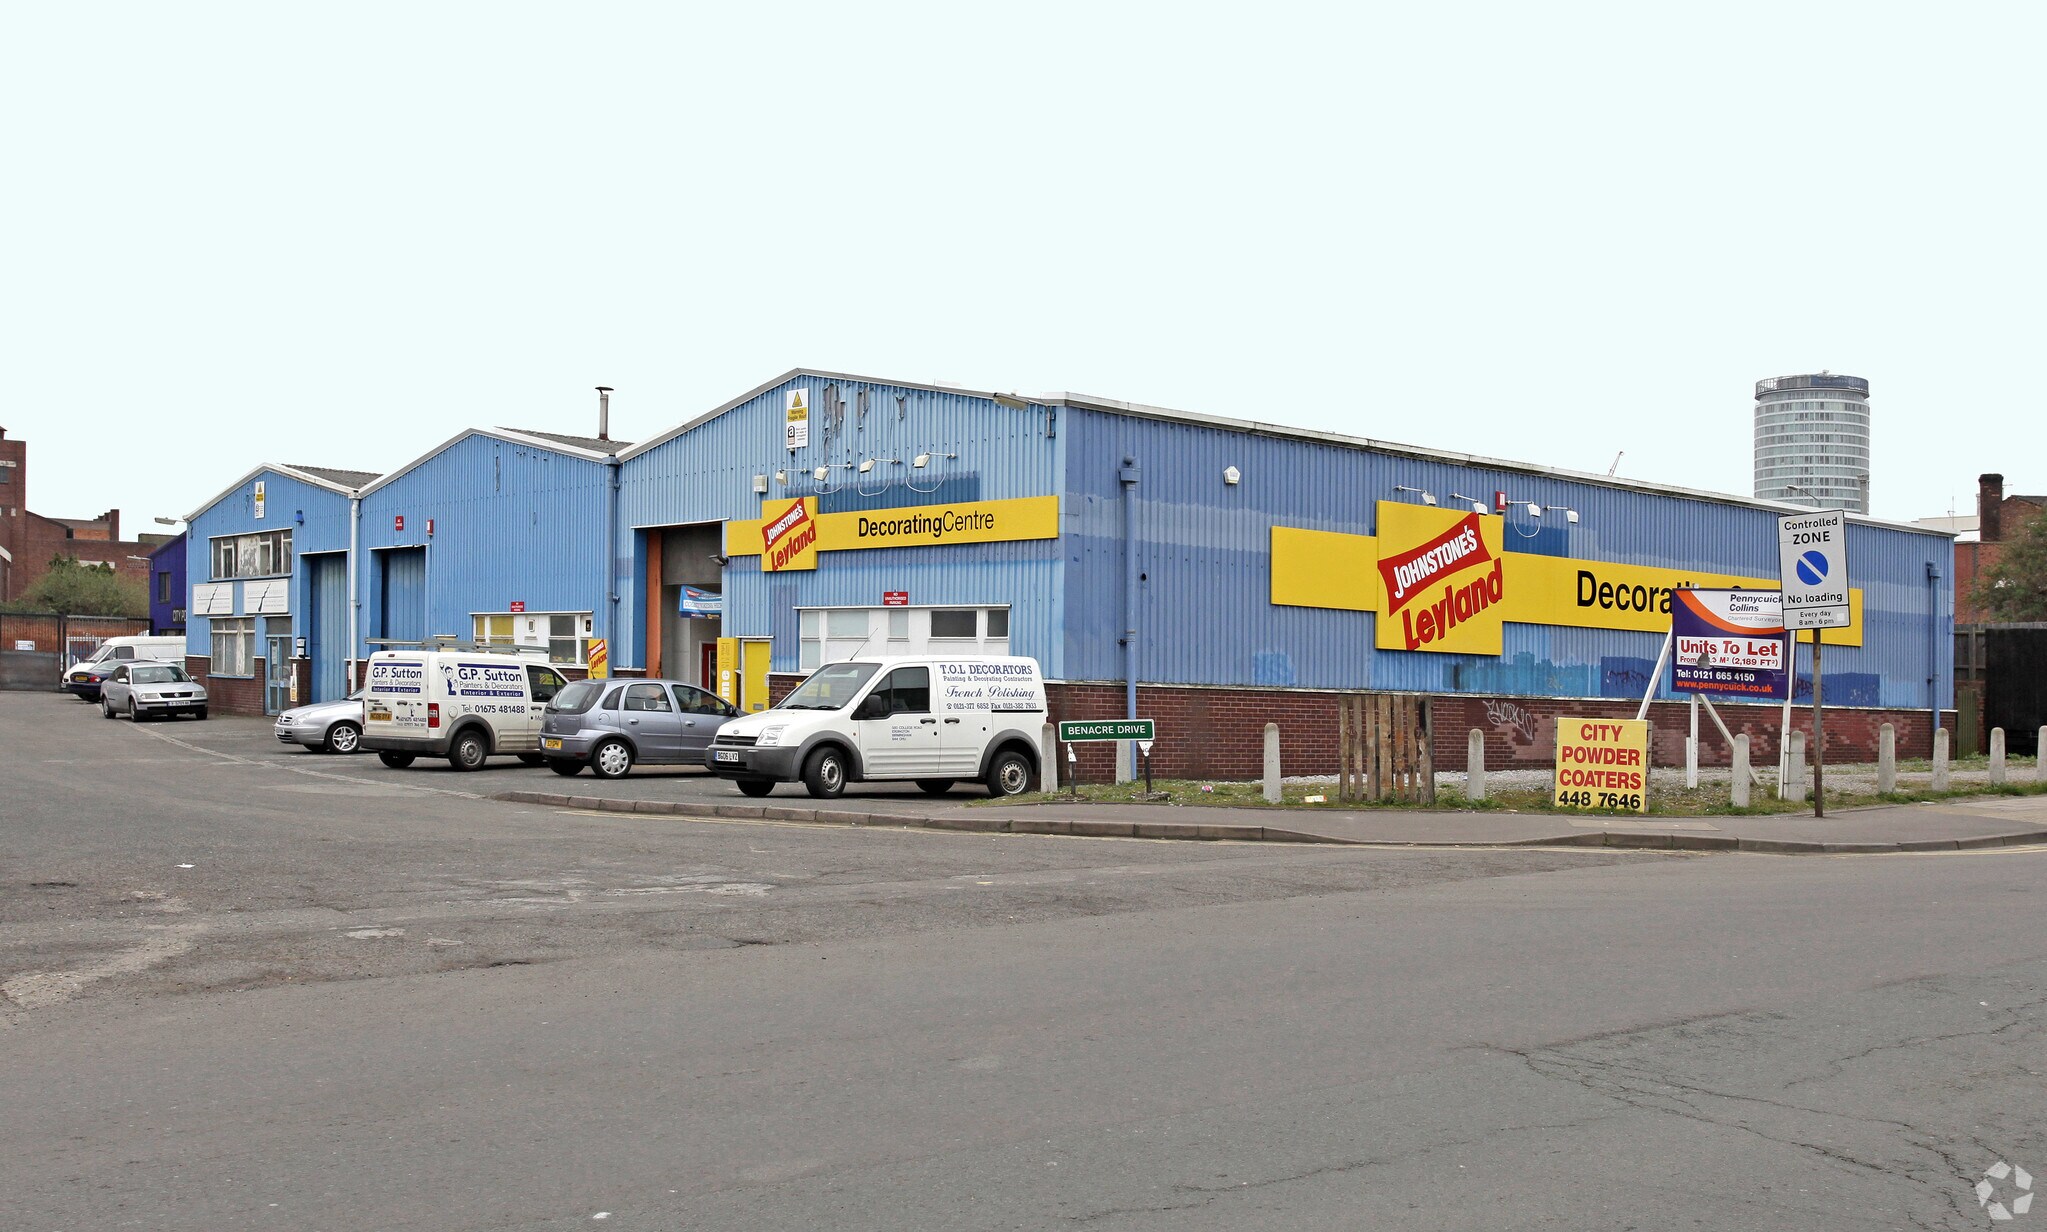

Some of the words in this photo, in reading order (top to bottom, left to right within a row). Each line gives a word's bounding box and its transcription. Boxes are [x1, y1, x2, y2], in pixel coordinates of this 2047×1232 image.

[767, 503, 804, 545] JOHNSTONE'S
[1784, 516, 1838, 530] Controlled
[1792, 530, 1831, 545] ZONE
[771, 519, 816, 571] Leyland
[1393, 524, 1478, 599] JOHNSTONE'S
[1401, 557, 1503, 651] Leyland
[1787, 594, 1802, 604] No
[1805, 593, 1843, 603] loading
[1729, 603, 1759, 612] Collins
[1754, 615, 1783, 624] Surveyor
[1680, 639, 1717, 654] Units
[1722, 640, 1740, 655] To
[1747, 641, 1778, 657] Let
[1732, 657, 1757, 665] (2,189
[372, 667, 388, 678] G.P.
[391, 667, 422, 678] Sutton
[458, 668, 481, 680] G.P.
[484, 669, 522, 682] Sutton
[940, 664, 966, 674] T.O.L
[969, 664, 1033, 675] DECORATORS
[1676, 669, 1691, 678] Tel:
[1693, 670, 1713, 679] 0121
[1715, 671, 1732, 680] 665
[1734, 672, 1755, 681] 4150
[460, 681, 483, 689] Painters
[492, 682, 523, 690] Decorators
[943, 675, 966, 683] Painting
[973, 675, 1002, 683] Decorating
[945, 685, 983, 698] French
[987, 685, 1035, 700] Polishing
[1676, 680, 1773, 693] www.pennycuick.co.uk
[461, 704, 472, 713] Tel:
[474, 704, 496, 713] 01675
[498, 705, 526, 714] 481488
[991, 702, 1001, 710] Fax
[1067, 725, 1114, 735] BENACRE
[1117, 725, 1146, 734] DRIVE
[1580, 723, 1623, 742] CITY
[1561, 745, 1640, 766] POWDER
[1559, 769, 1641, 790] COATERS
[1558, 790, 1591, 807] 448
[1598, 792, 1641, 809] 7646
